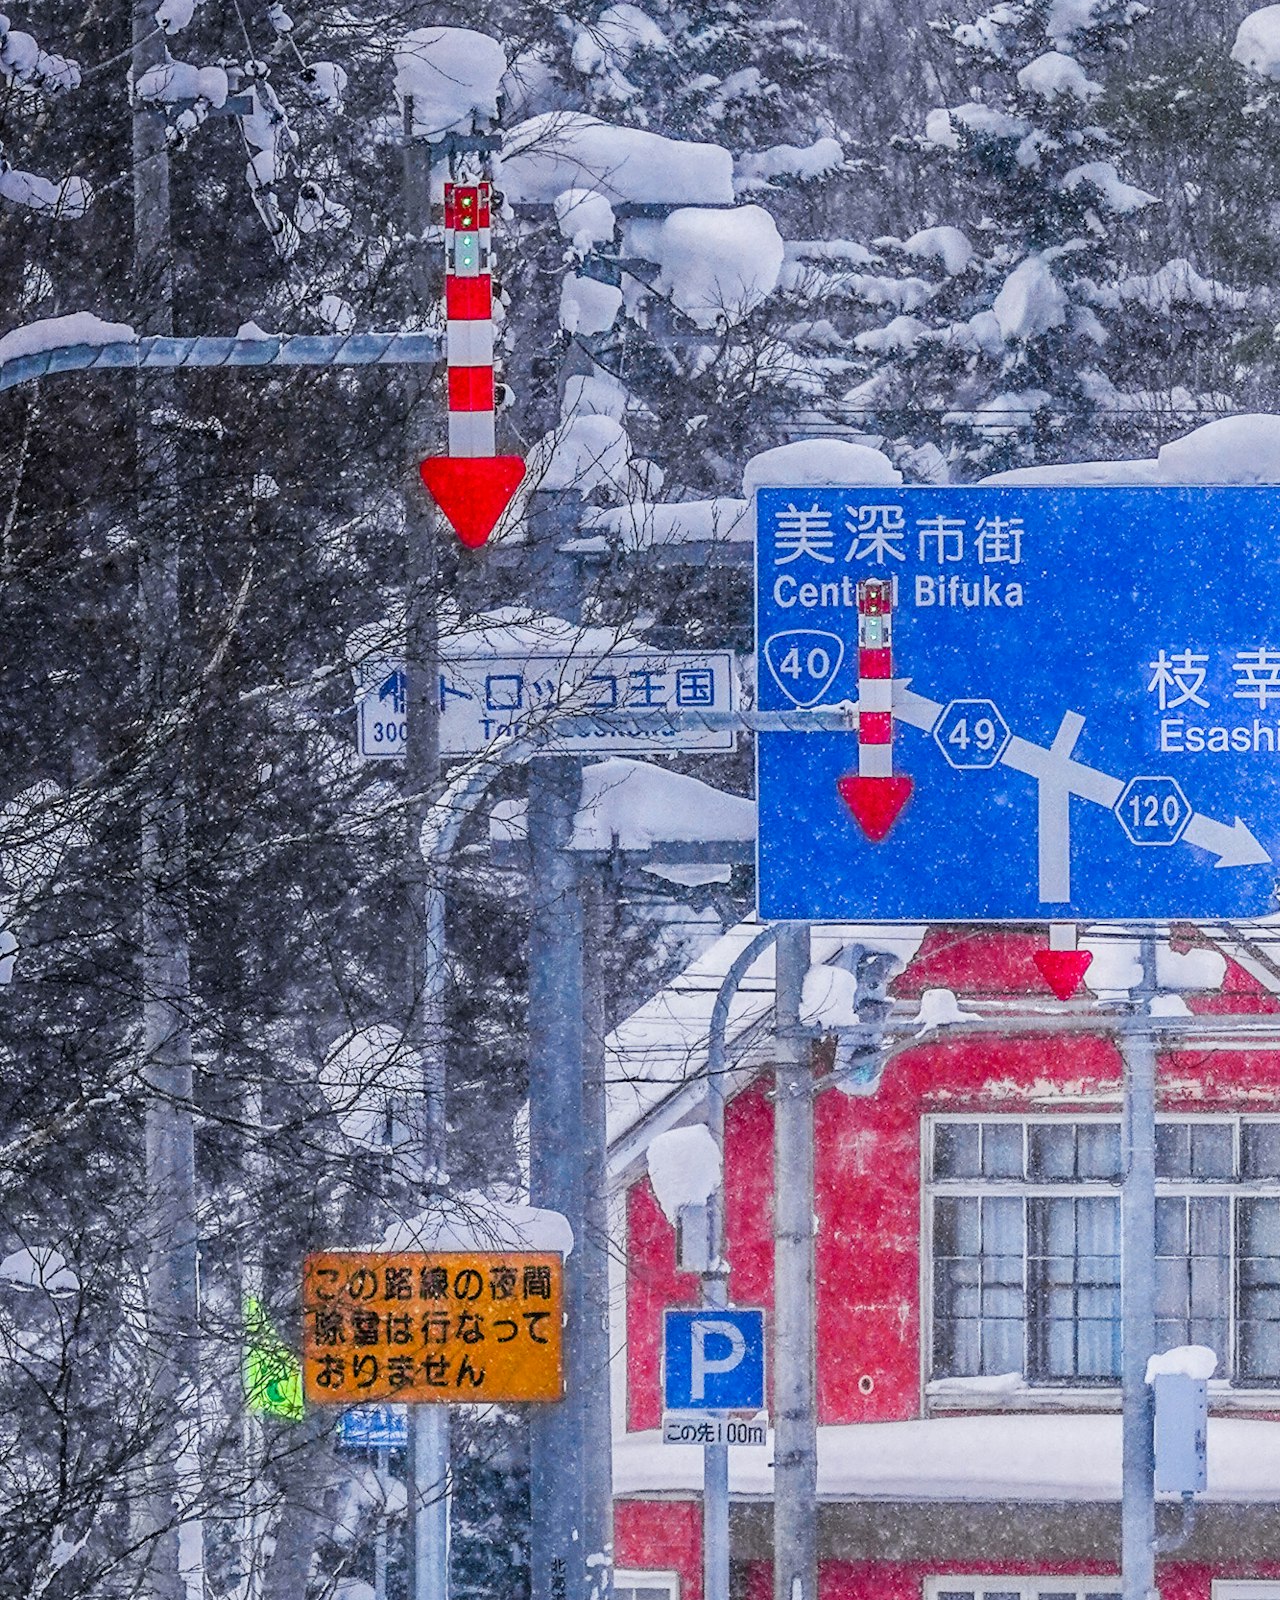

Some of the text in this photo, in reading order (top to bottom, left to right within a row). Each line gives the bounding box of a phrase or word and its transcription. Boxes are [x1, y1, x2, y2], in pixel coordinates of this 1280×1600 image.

[774, 503, 1025, 565] 美深市街
[773, 574, 1024, 608] Centl Bifuka
[780, 647, 830, 680] 40
[948, 718, 996, 751] 49
[1128, 795, 1180, 828] 120
[316, 1266, 551, 1300] この路線の夜間
[315, 1309, 551, 1346] 除雪は行なって
[315, 1353, 487, 1389] おりません
[690, 1320, 746, 1400] P
